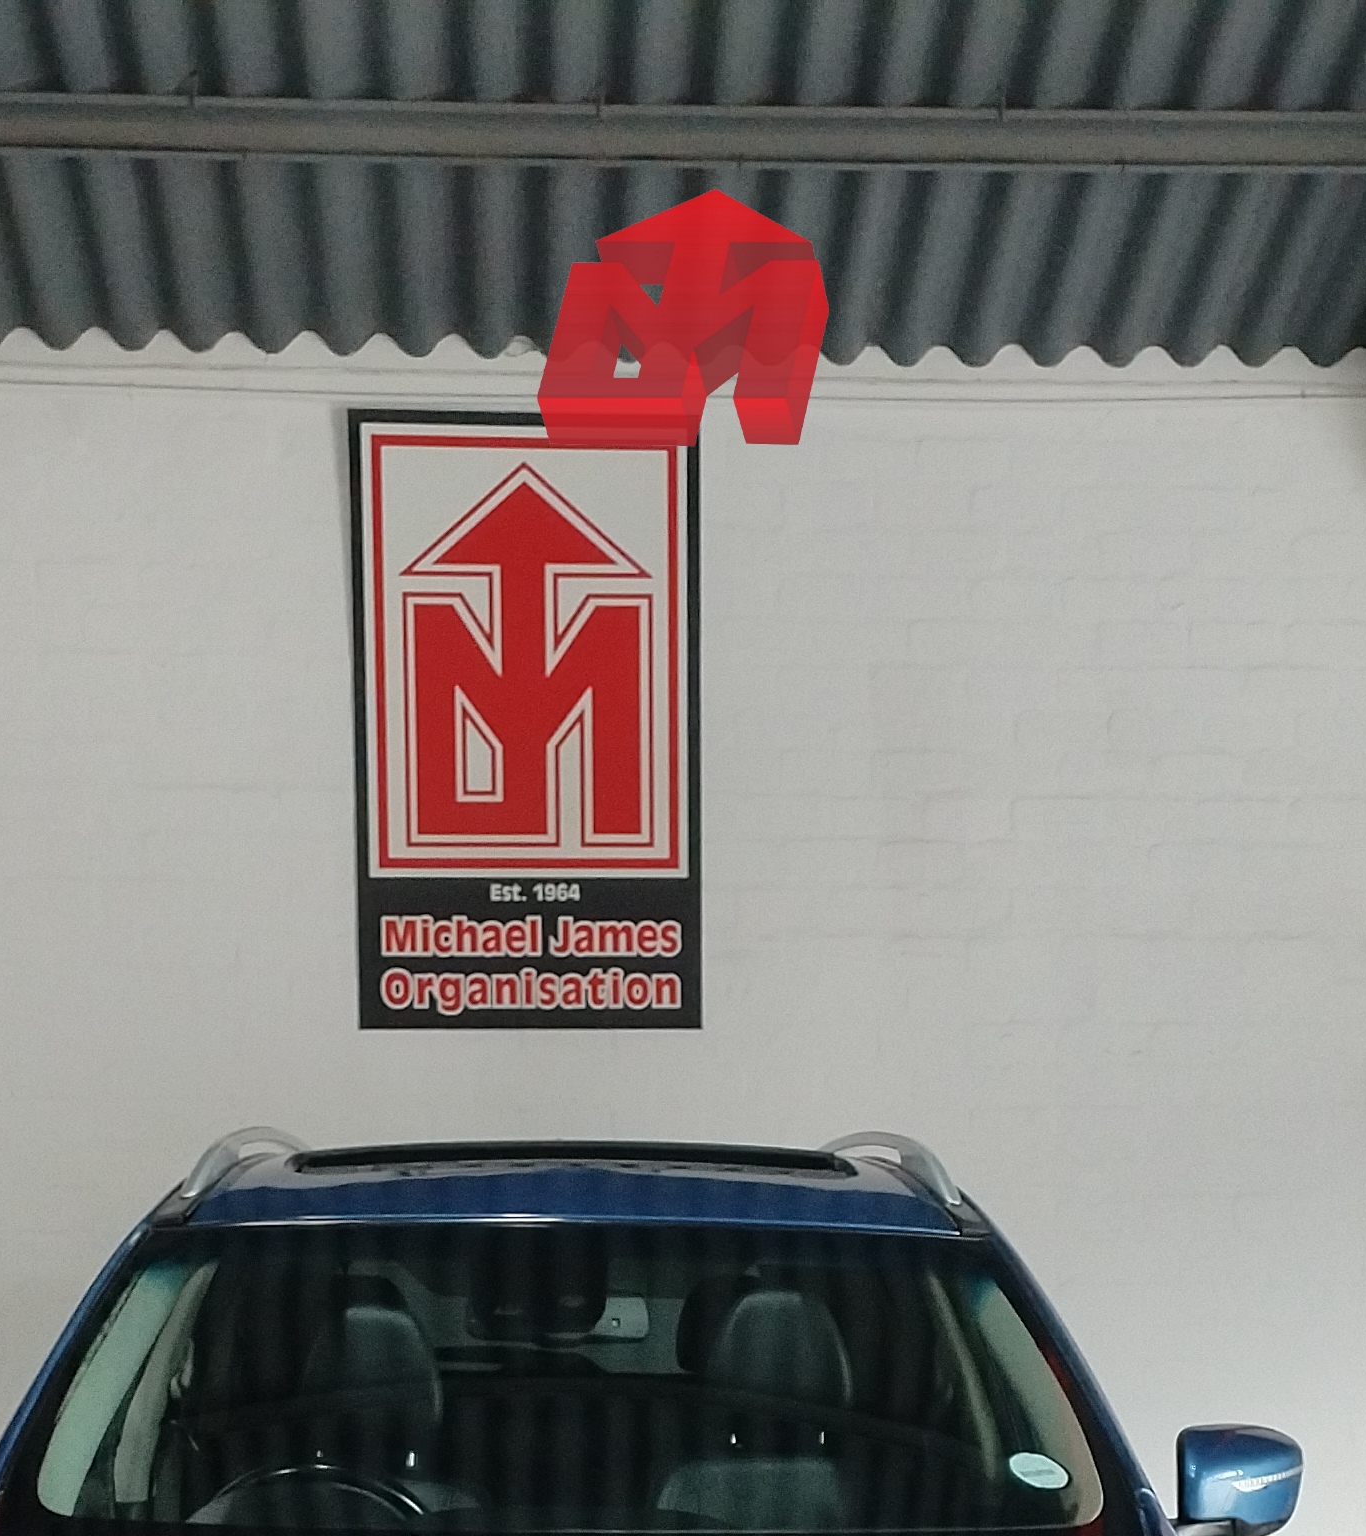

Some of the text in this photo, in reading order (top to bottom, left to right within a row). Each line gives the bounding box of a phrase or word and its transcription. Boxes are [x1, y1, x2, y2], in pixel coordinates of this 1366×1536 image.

[489, 883, 581, 903] Est. 1964
[380, 915, 682, 960] Michael James
[380, 969, 682, 1016] Organisation
